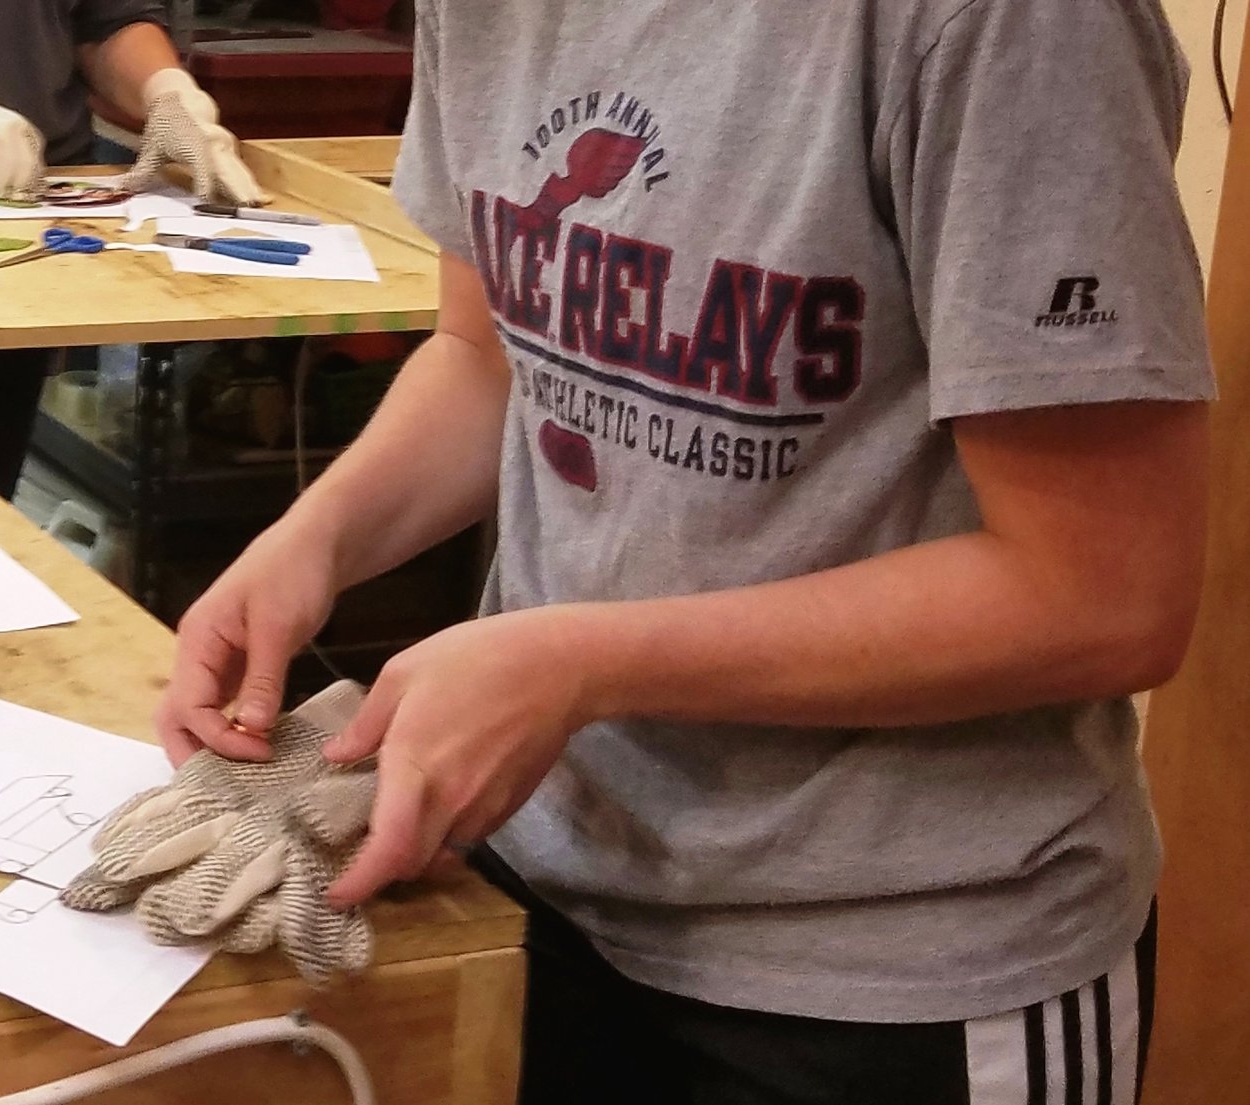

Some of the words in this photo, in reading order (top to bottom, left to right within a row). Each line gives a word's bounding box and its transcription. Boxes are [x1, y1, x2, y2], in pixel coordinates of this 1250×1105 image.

[522, 91, 601, 161] 100TH
[559, 223, 866, 406] RELAYS
[648, 413, 800, 482] CLASSIC
